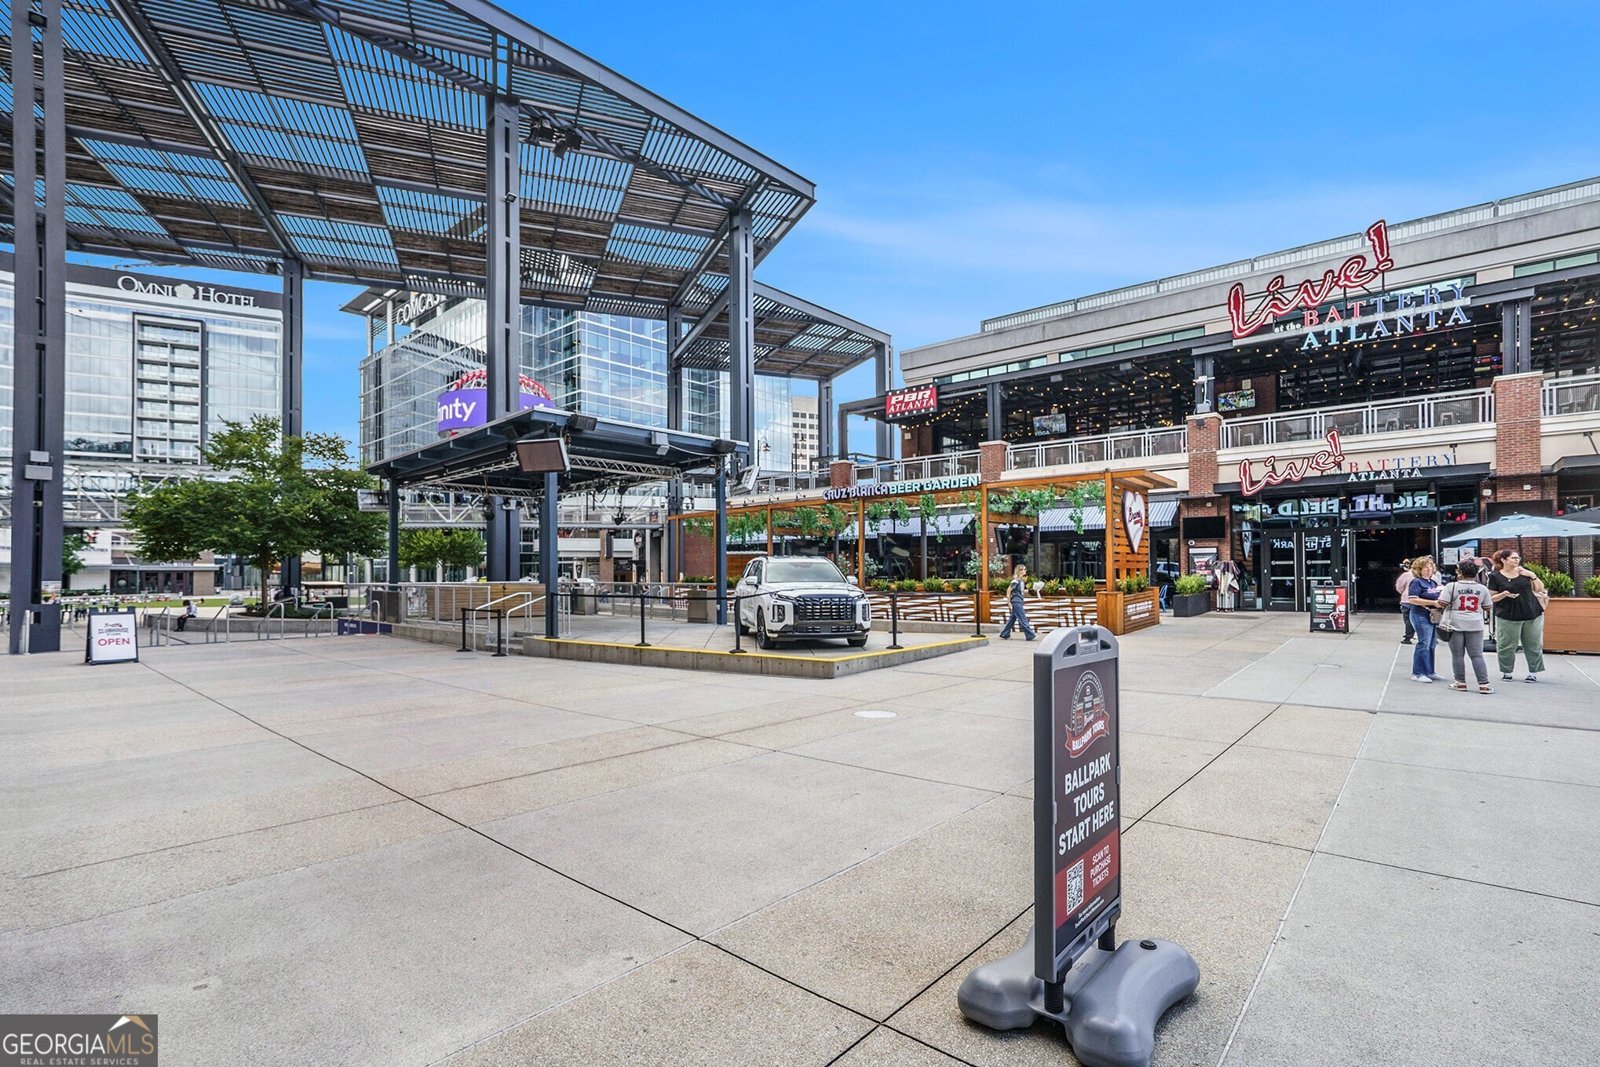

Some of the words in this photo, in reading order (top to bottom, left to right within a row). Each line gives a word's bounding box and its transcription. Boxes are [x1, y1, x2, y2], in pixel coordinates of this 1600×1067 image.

[117, 275, 173, 297] OMNI
[196, 286, 256, 308] HOTEL
[1228, 219, 1394, 339] Live!
[1302, 281, 1470, 327] BATTERY
[1301, 305, 1471, 351] ATLANTA
[889, 398, 935, 413] ATLANTA
[891, 390, 931, 405] PBR
[1239, 428, 1345, 496] Live!
[1347, 467, 1423, 482] ATLANTA
[1348, 452, 1455, 473] BATTERY
[850, 484, 888, 498] BLANCA
[889, 482, 921, 495] BEER
[923, 475, 979, 491] GARDEN
[1458, 595, 1479, 611] 13
[98, 637, 131, 646] OPEN
[1072, 727, 1093, 751] BALLPARK
[1092, 719, 1105, 735] TOURS
[1065, 752, 1111, 795] BALLPARK
[1073, 782, 1105, 817] TOURS
[1059, 816, 1091, 856] START
[1092, 800, 1115, 833] HERE
[1090, 854, 1111, 879] PURCHASE
[1092, 848, 1104, 865] SCAN
[1103, 844, 1110, 856] TO
[1092, 867, 1109, 888] TICKETS
